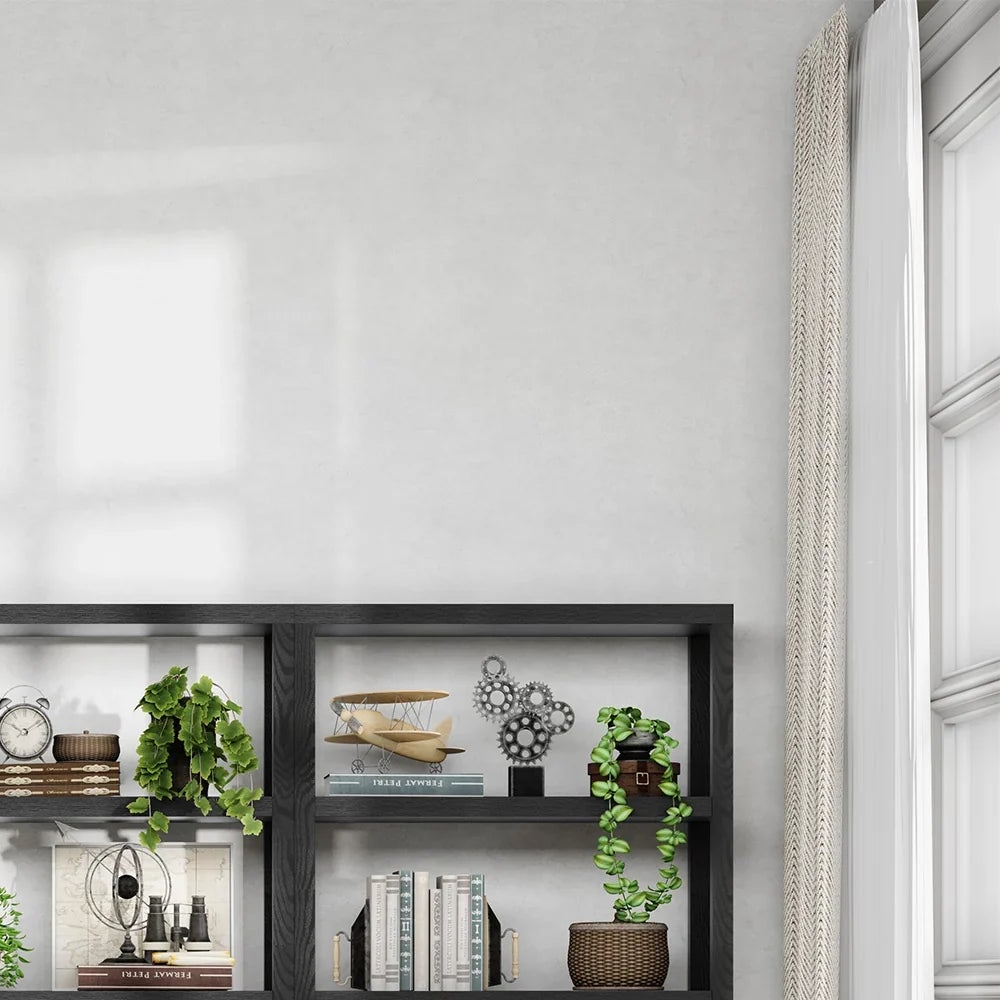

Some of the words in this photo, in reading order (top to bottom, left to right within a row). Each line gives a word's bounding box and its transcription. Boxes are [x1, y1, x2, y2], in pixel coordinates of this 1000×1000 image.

[373, 779, 401, 787] PETRI
[405, 779, 443, 787] FERMAT
[153, 971, 191, 979] FERMAT
